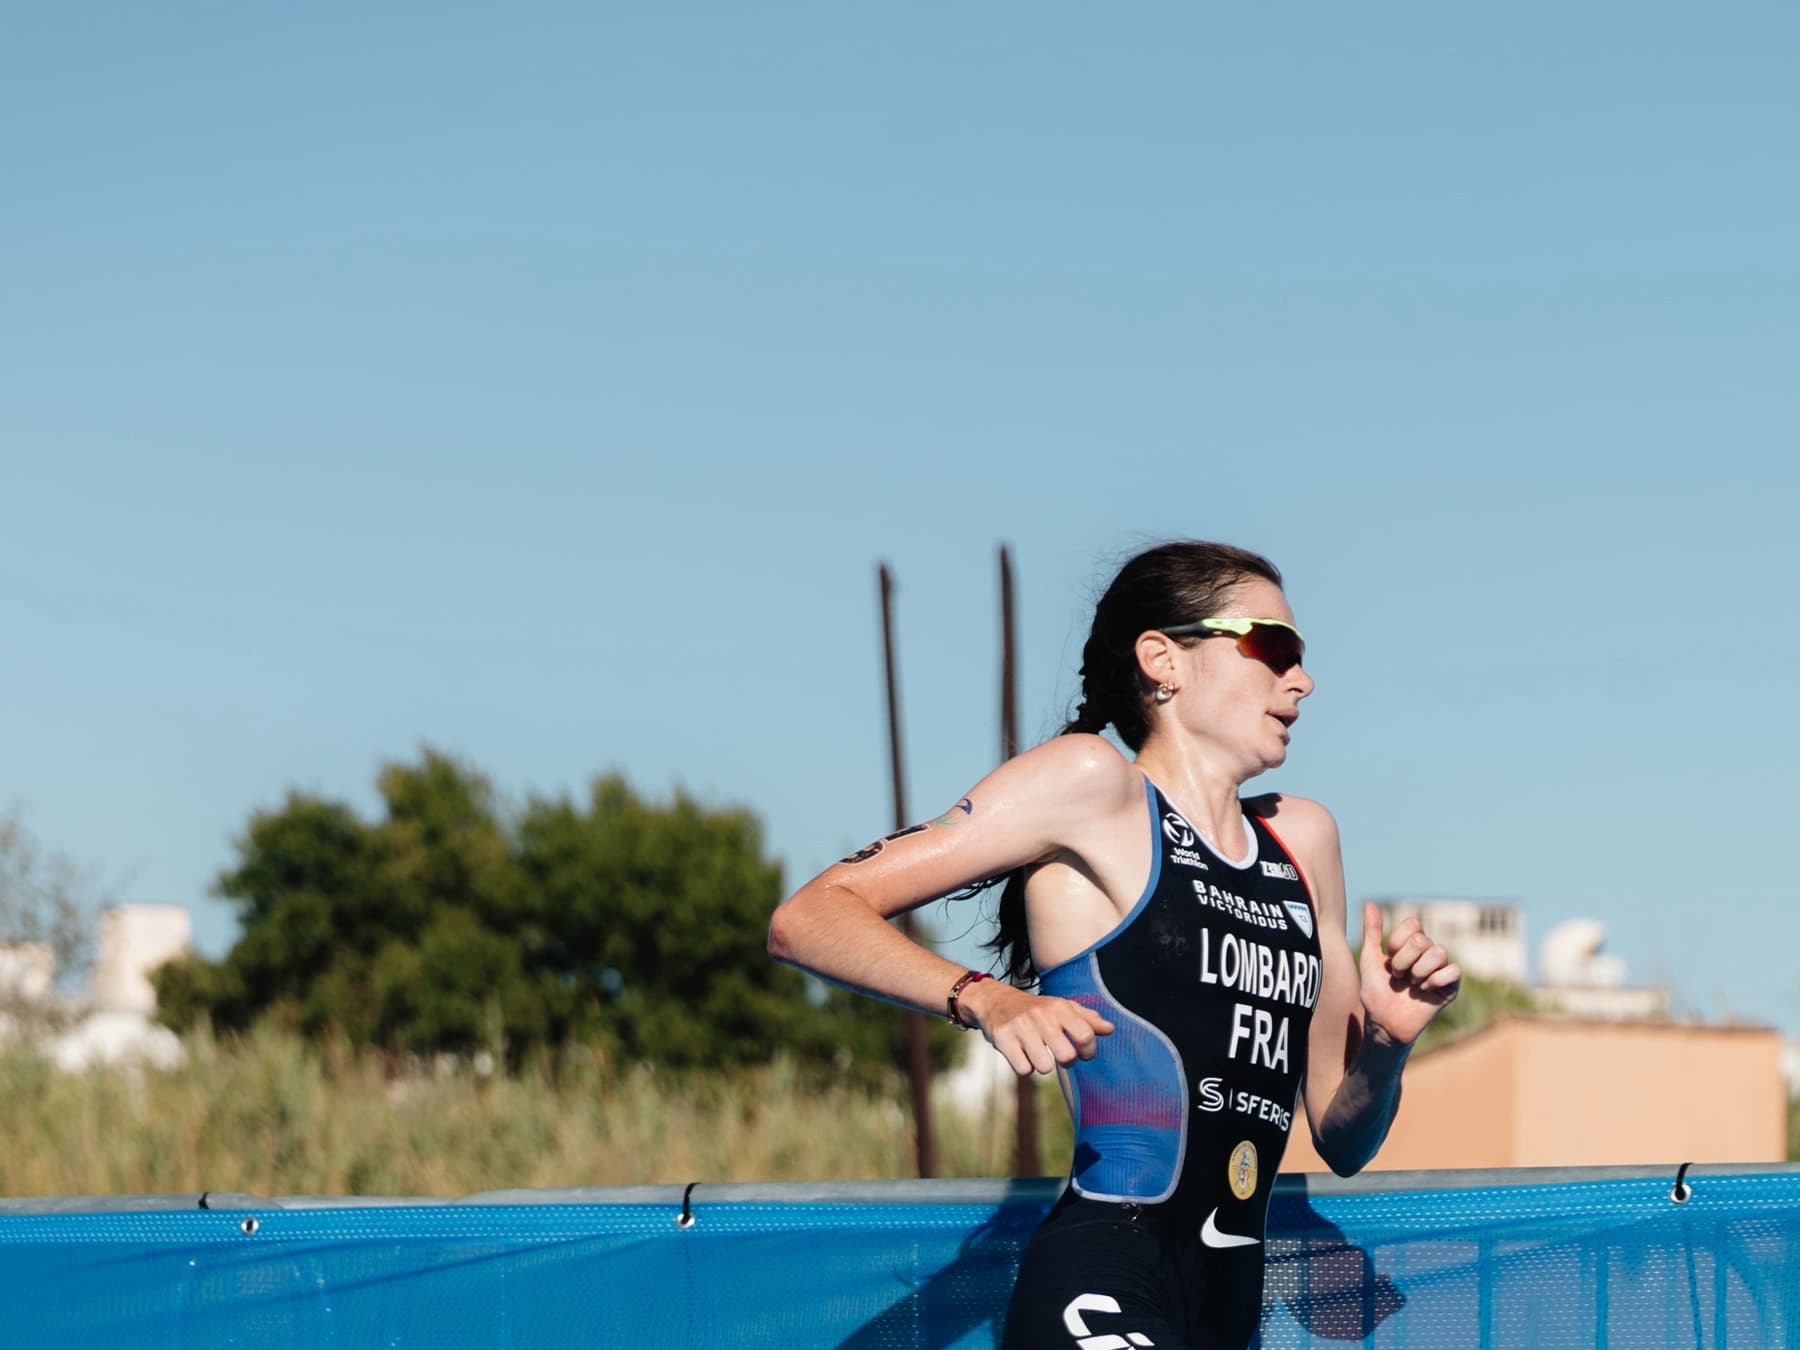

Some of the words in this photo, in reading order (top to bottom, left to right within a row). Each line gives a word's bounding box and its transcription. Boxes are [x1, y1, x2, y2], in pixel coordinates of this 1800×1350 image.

[1192, 879, 1285, 919] BAHRAIN
[1197, 894, 1289, 931] VICTORIOUS
[1227, 1003, 1289, 1074] FRA
